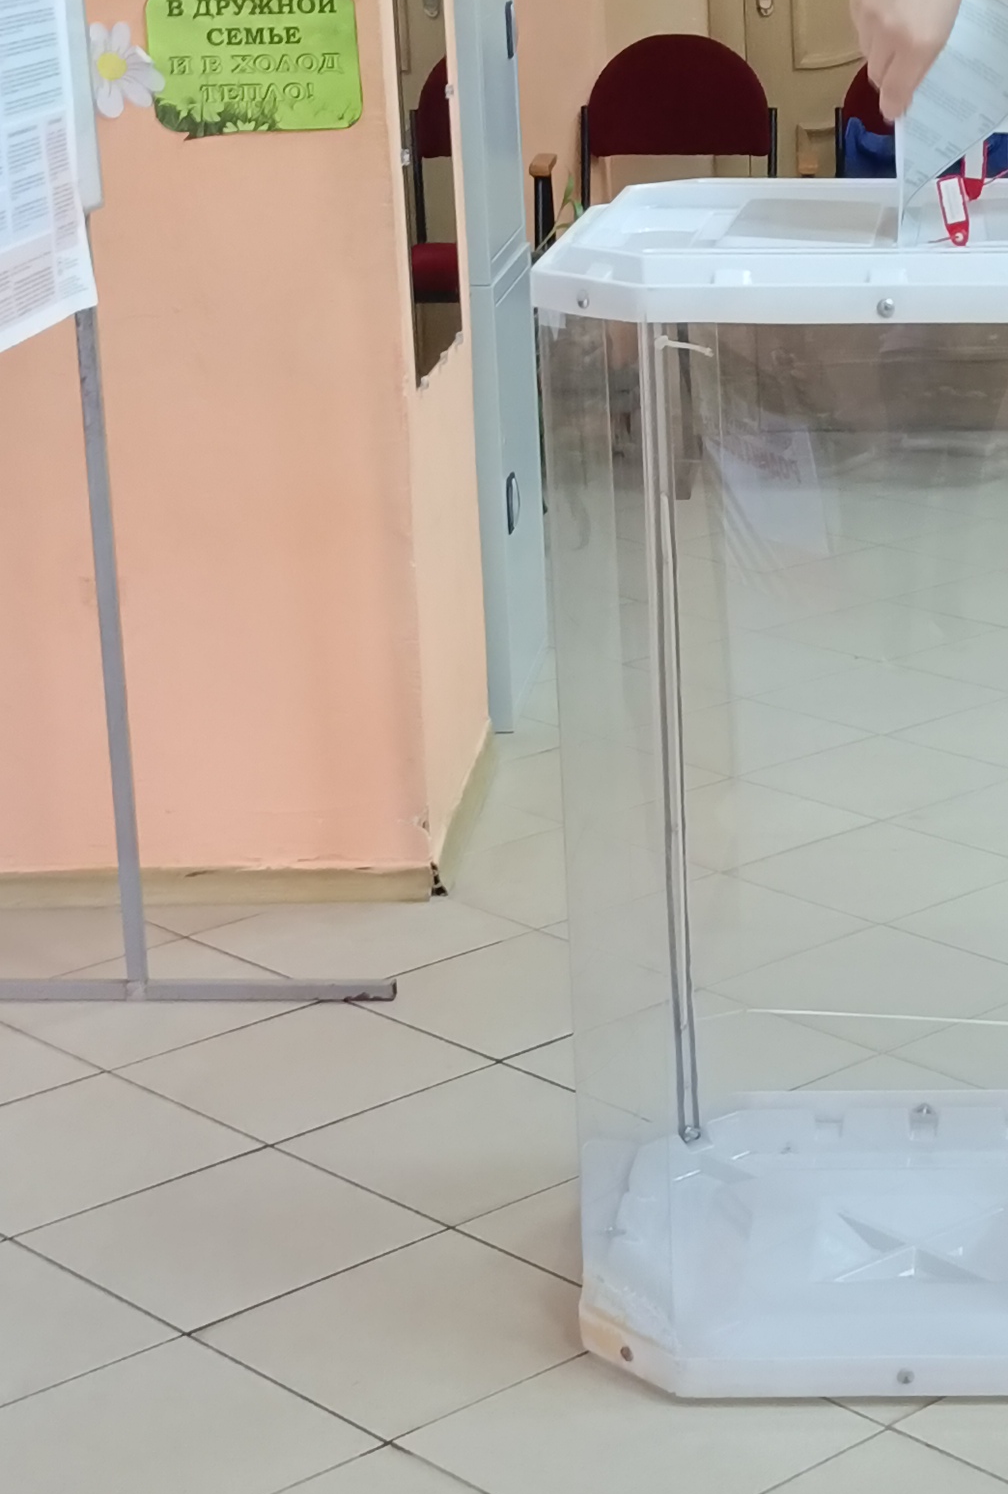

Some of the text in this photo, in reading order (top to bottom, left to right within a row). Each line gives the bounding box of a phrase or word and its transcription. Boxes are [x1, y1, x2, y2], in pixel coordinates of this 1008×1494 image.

[166, 0, 184, 17] В
[206, 26, 302, 46] СЕМЬЕ
[170, 53, 344, 76] И В ХОЛОД
[200, 82, 315, 103] ТЕПЛО!
